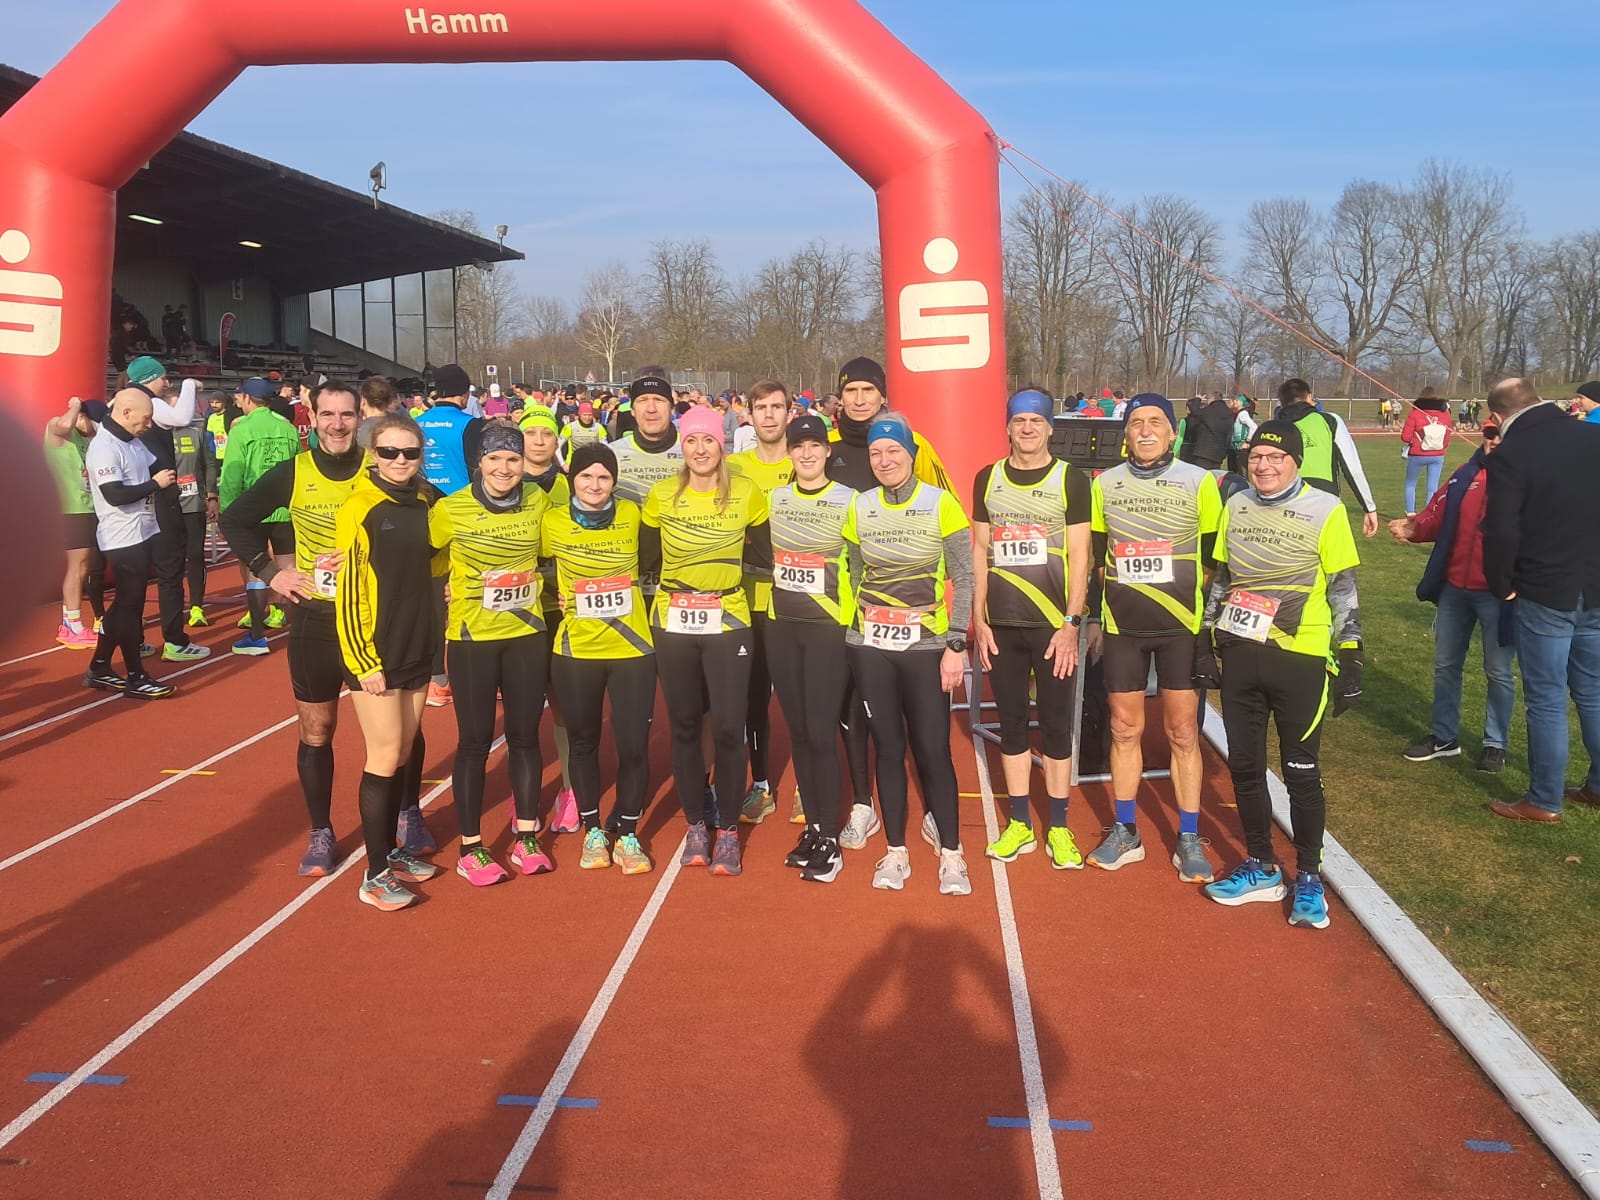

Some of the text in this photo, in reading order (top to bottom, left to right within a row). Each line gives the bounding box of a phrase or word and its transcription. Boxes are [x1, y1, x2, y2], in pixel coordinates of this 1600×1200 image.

[404, 7, 509, 34] Hamm
[685, 522, 722, 530] MENDEN
[786, 516, 822, 524] MENDEN
[492, 529, 529, 540] MENDEN
[1243, 536, 1282, 545] MENDEN
[585, 547, 622, 556] MENDEN
[1001, 541, 1039, 556] 1166
[1124, 557, 1164, 573] 1999
[780, 566, 816, 583] 2035
[493, 584, 531, 602] 2510
[584, 591, 624, 609] 1815
[680, 610, 708, 624] 919
[1228, 606, 1260, 629] 1821
[872, 623, 912, 640] 2729
